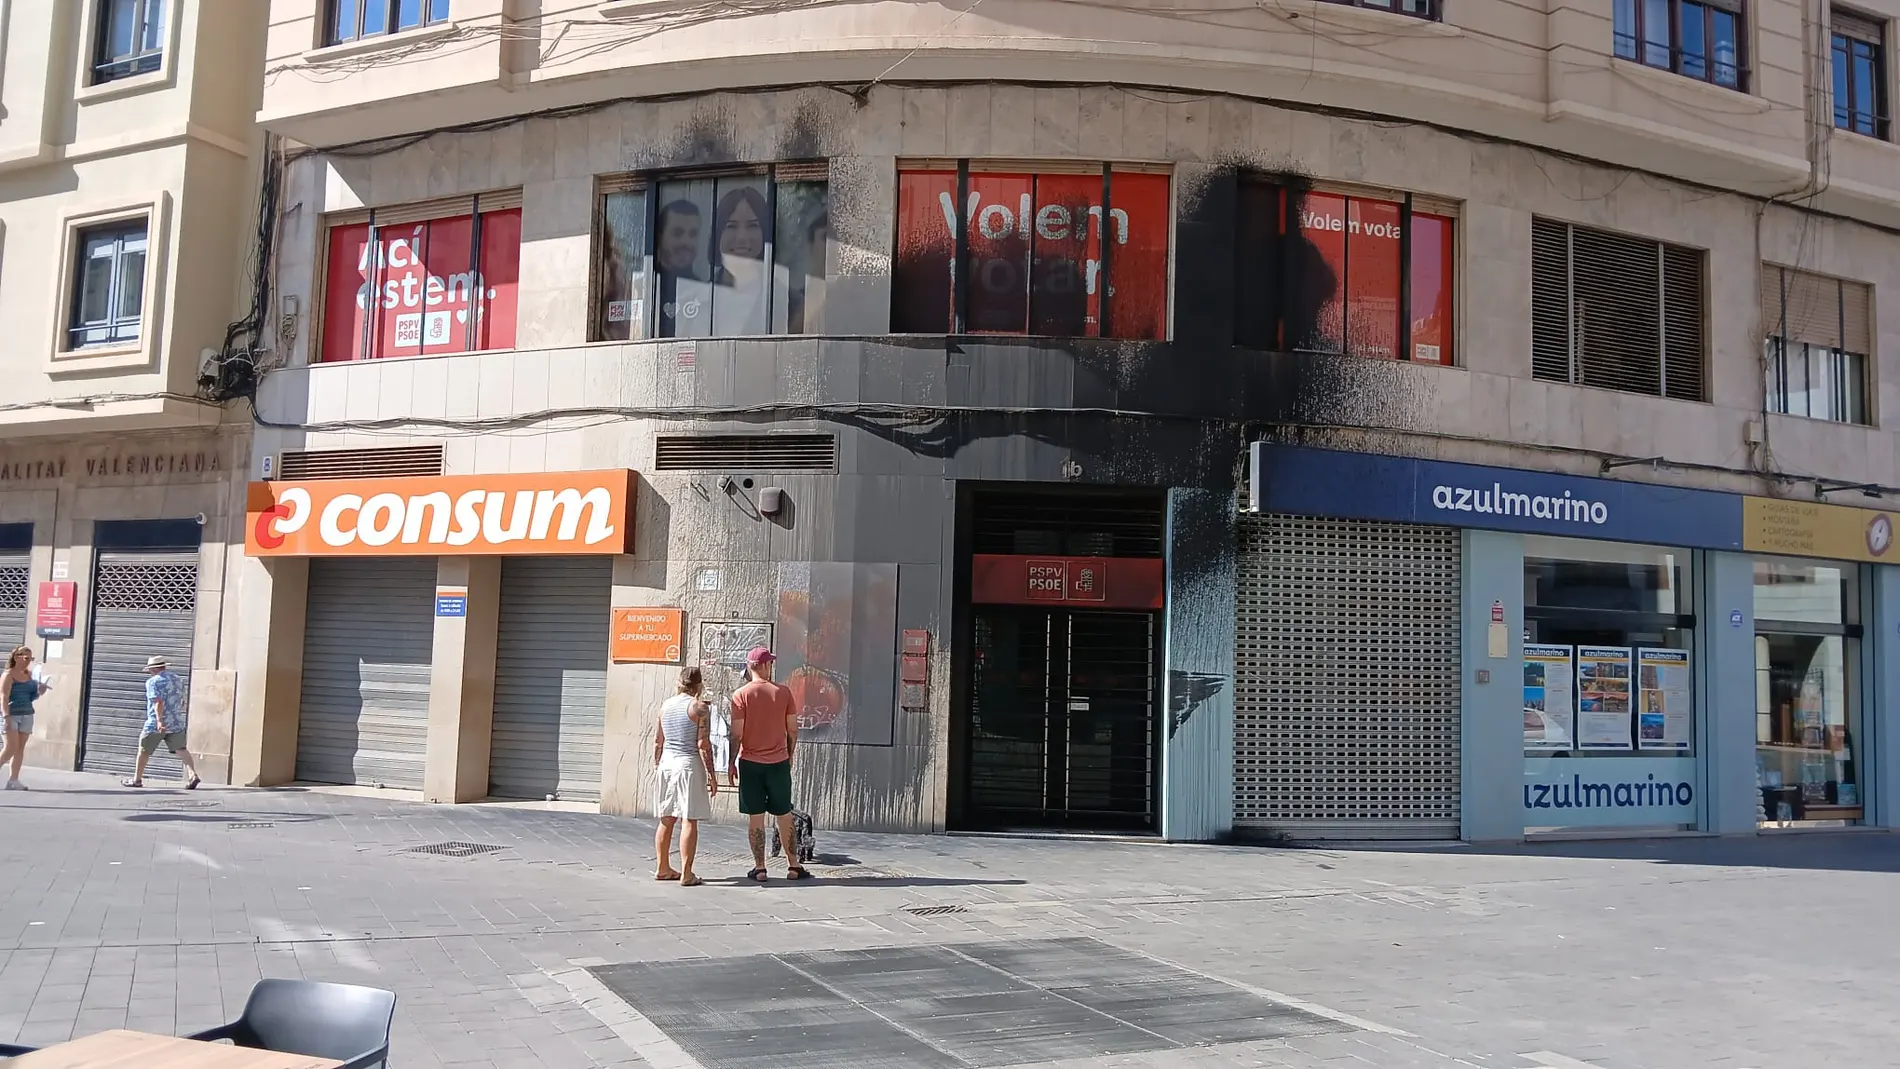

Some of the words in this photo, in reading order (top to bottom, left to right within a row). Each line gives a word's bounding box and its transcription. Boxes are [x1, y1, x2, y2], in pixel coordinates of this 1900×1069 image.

[939, 191, 1129, 245] Volem
[358, 225, 423, 270] Ací
[356, 268, 496, 311] estem.
[398, 318, 420, 330] PSPV
[398, 329, 419, 341] PSOE
[1, 457, 67, 480] ALITAT
[86, 452, 221, 477] VALENCIANA
[1432, 483, 1608, 524] azulmarino
[319, 487, 614, 547] consum
[1029, 567, 1063, 578] PSPV
[1029, 578, 1062, 591] PSOE
[627, 614, 666, 623] BIENVENIDO
[639, 624, 643, 632] A
[645, 624, 654, 632] TU
[619, 633, 673, 641] SUPERMERCADO
[1524, 648, 1564, 657] azulmarino
[1584, 649, 1624, 658] azulmarino
[1645, 652, 1682, 661] azulmarino
